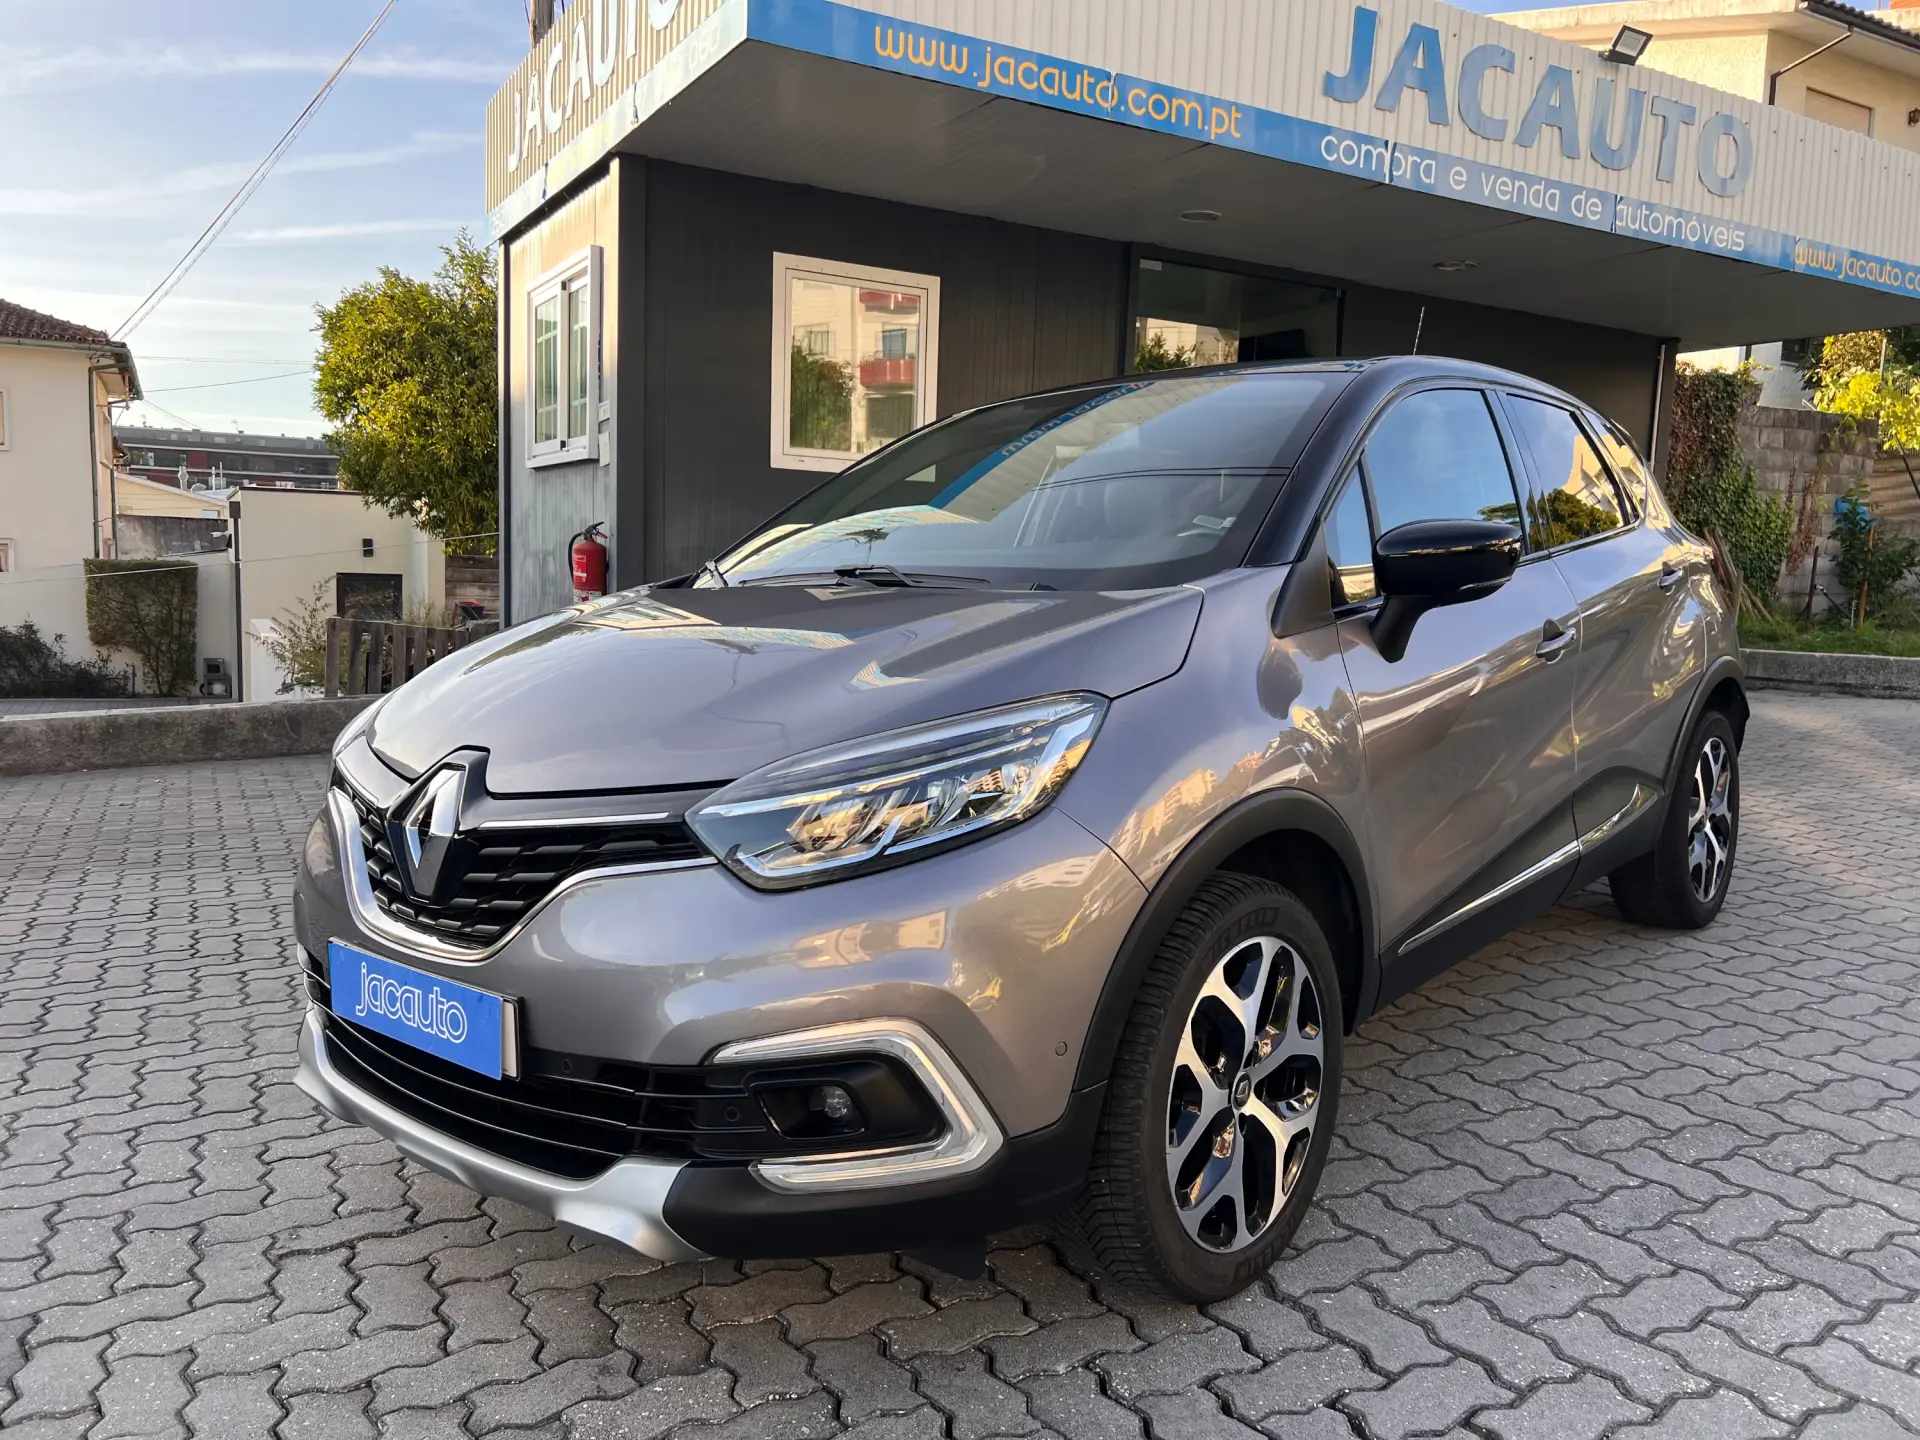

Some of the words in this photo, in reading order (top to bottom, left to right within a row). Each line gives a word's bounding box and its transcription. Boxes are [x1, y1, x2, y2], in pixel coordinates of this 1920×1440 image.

[508, 0, 683, 174] JACAU
[874, 25, 1243, 139] www.jacauto.com.pt
[1324, 5, 1754, 197] JACAUTO
[1321, 135, 1436, 184] compra
[1450, 166, 1467, 191] e
[1481, 171, 1560, 213] venda
[1571, 189, 1602, 221] de
[1615, 203, 1745, 251] automóveis
[355, 961, 468, 1044] jacauto
